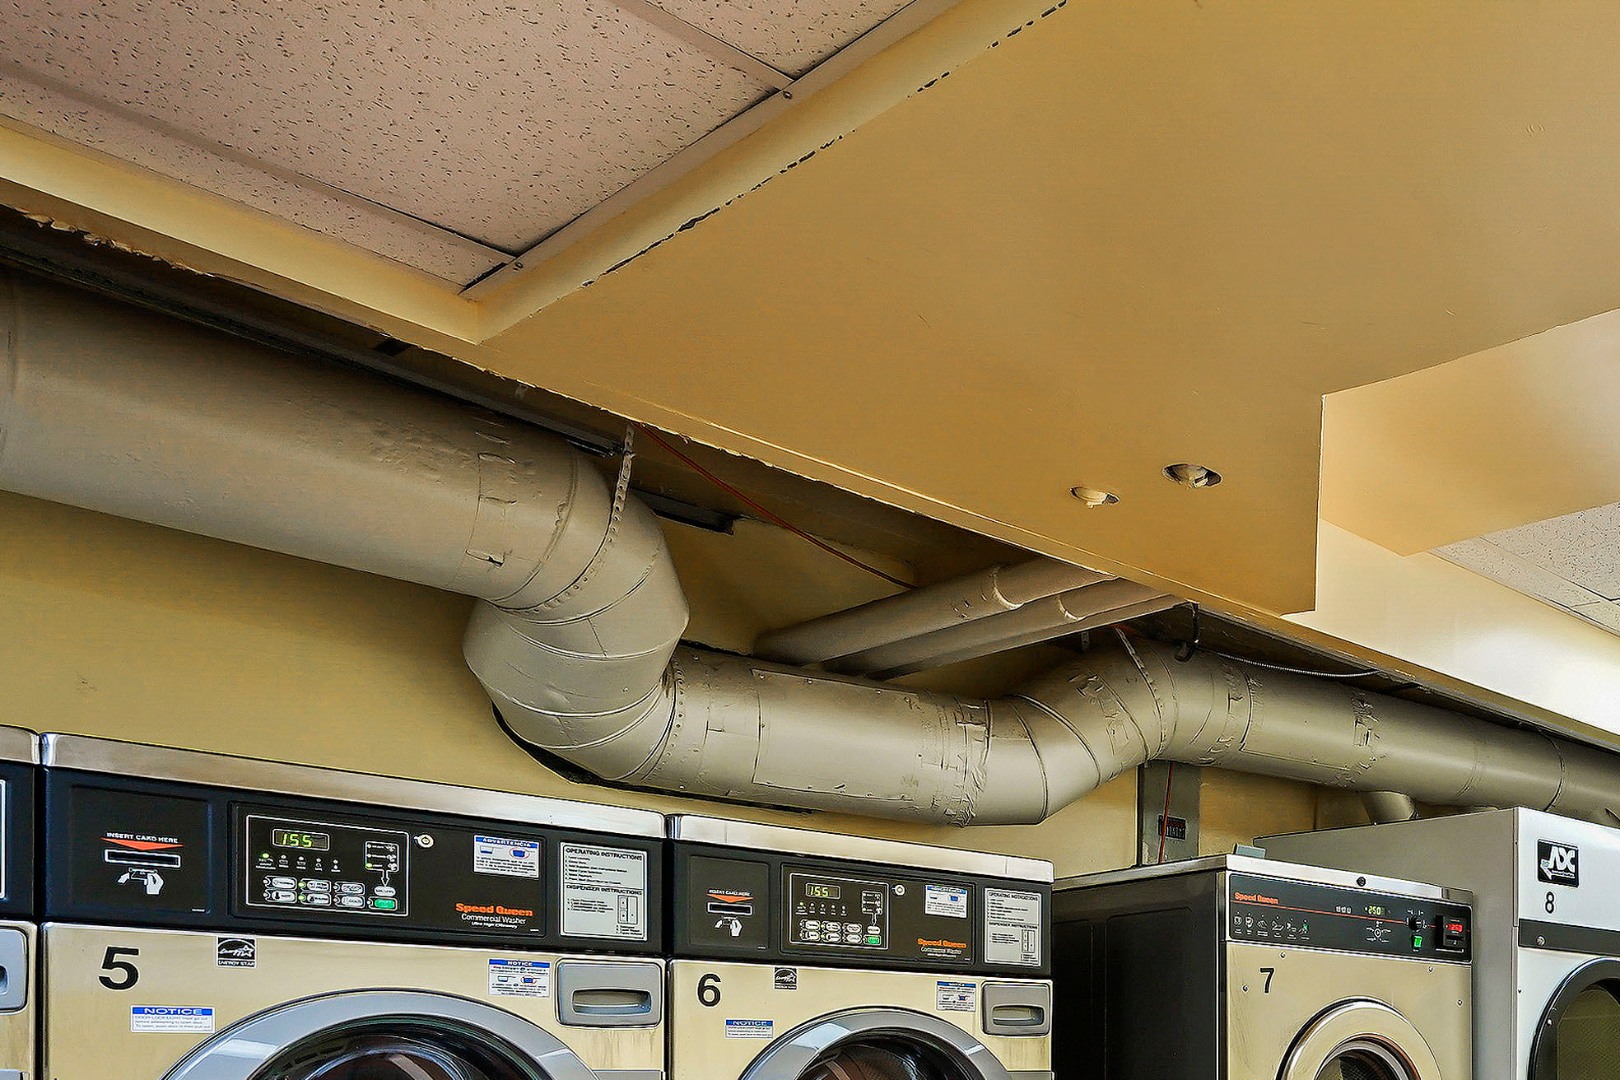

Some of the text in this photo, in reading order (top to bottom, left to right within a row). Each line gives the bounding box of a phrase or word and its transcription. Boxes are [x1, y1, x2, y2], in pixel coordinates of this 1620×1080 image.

[106, 832, 134, 840] INSERT
[282, 833, 312, 848] 155
[566, 848, 642, 861] OPERATING INSTRUCTIONS
[601, 888, 642, 896] INSTRUCTIONS
[810, 886, 829, 897] 155
[1234, 892, 1278, 904] Speed Queen
[455, 902, 533, 916] Speed Queen
[1545, 891, 1555, 914] 8
[462, 914, 526, 924] Commercial Washer
[98, 946, 140, 990] 5
[1260, 968, 1274, 994] 7
[697, 974, 722, 1007] 6
